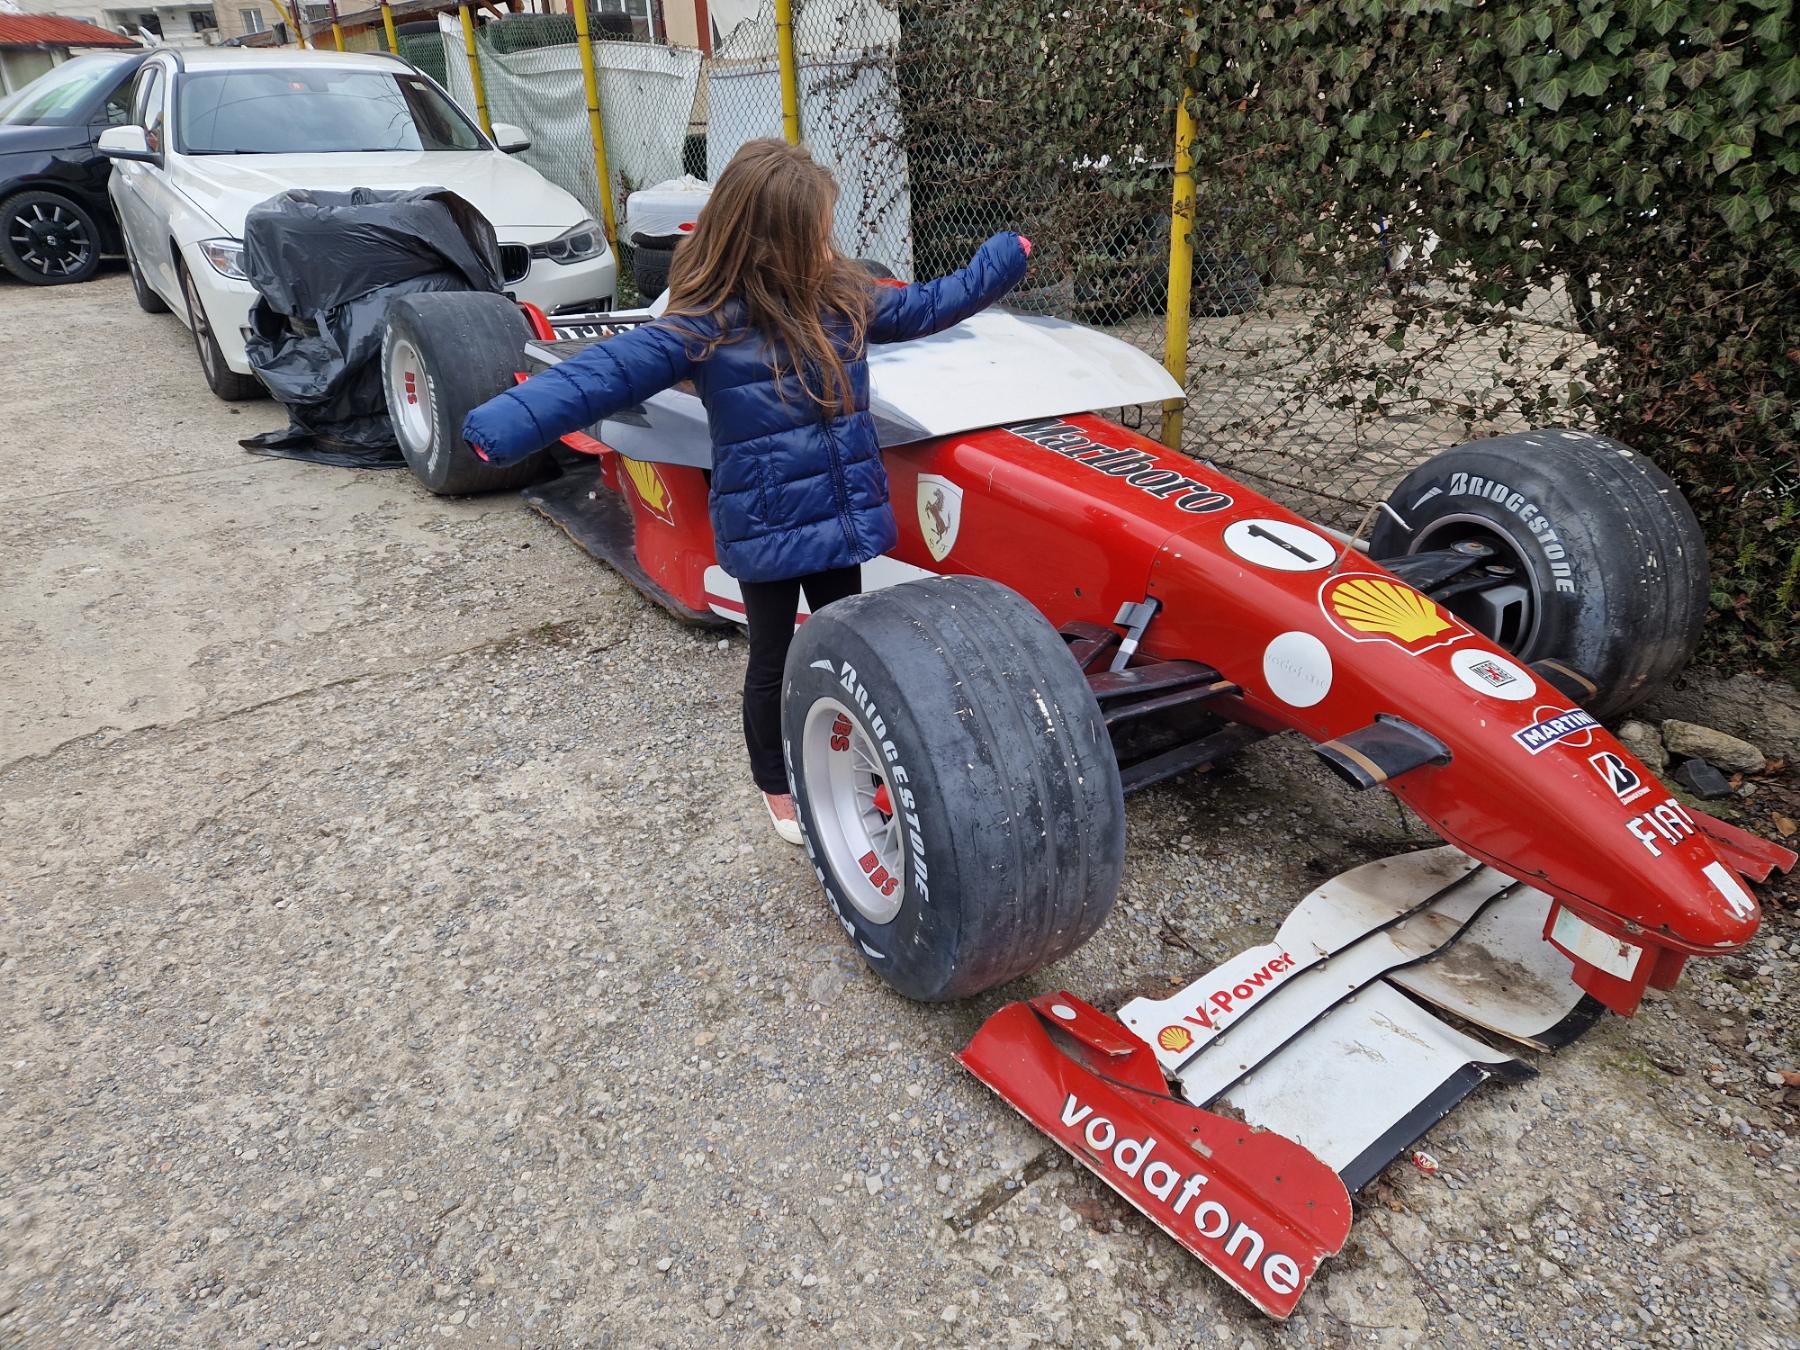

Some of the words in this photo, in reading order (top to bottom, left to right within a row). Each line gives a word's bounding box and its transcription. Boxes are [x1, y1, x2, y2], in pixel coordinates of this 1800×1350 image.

[1000, 418, 1234, 513] Marlboro
[1247, 524, 1318, 563] 1
[1449, 472, 1576, 594] BRIDGESTONE
[1523, 711, 1597, 747] MARTINI
[840, 661, 930, 903] BRIDGESTONE
[1625, 798, 1695, 857] FIAT
[858, 850, 899, 896] BBS
[1184, 951, 1296, 1029] V-Power
[1059, 1093, 1301, 1295] vodafone
